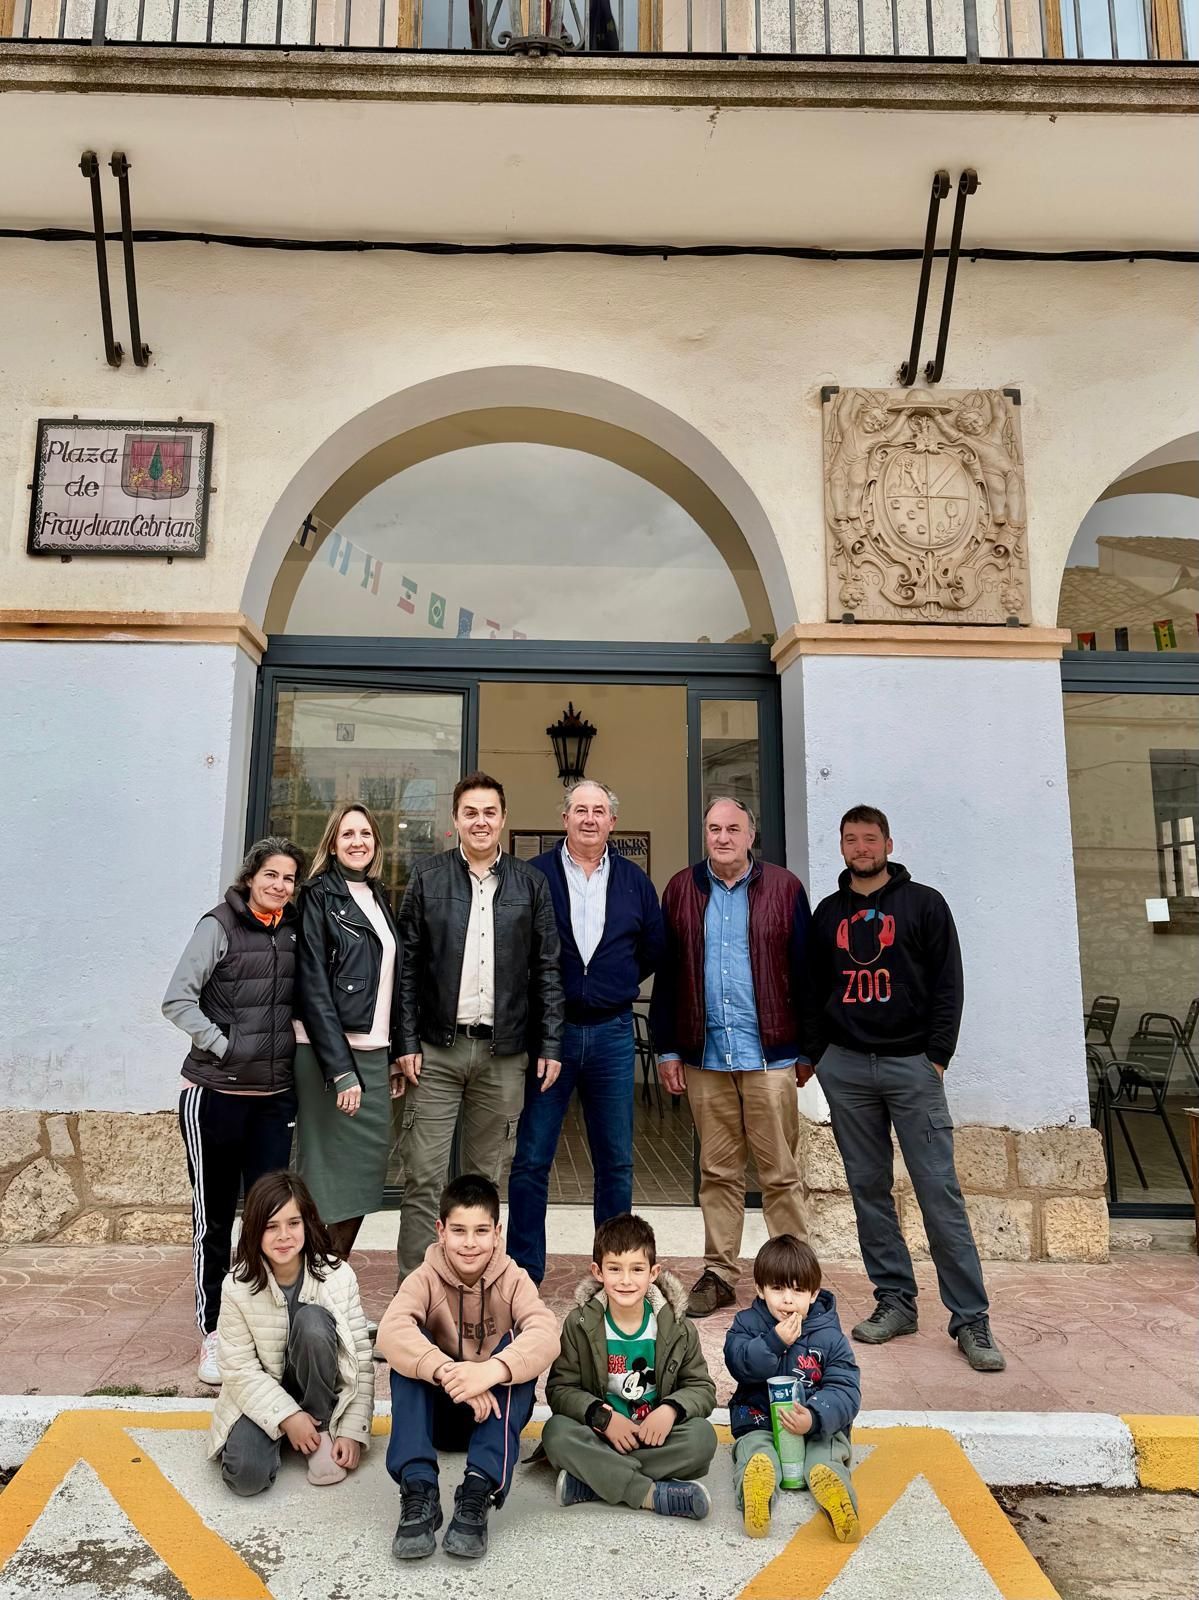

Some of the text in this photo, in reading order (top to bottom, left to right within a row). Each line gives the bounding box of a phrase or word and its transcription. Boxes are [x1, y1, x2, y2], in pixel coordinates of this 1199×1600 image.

[46, 440, 119, 464] Plaza
[64, 474, 100, 498] de
[39, 511, 84, 541] Fray
[609, 837, 648, 848] MICRO
[617, 847, 648, 857] IERTO
[841, 968, 892, 1003] ZOO
[608, 1354, 627, 1365] CKEY
